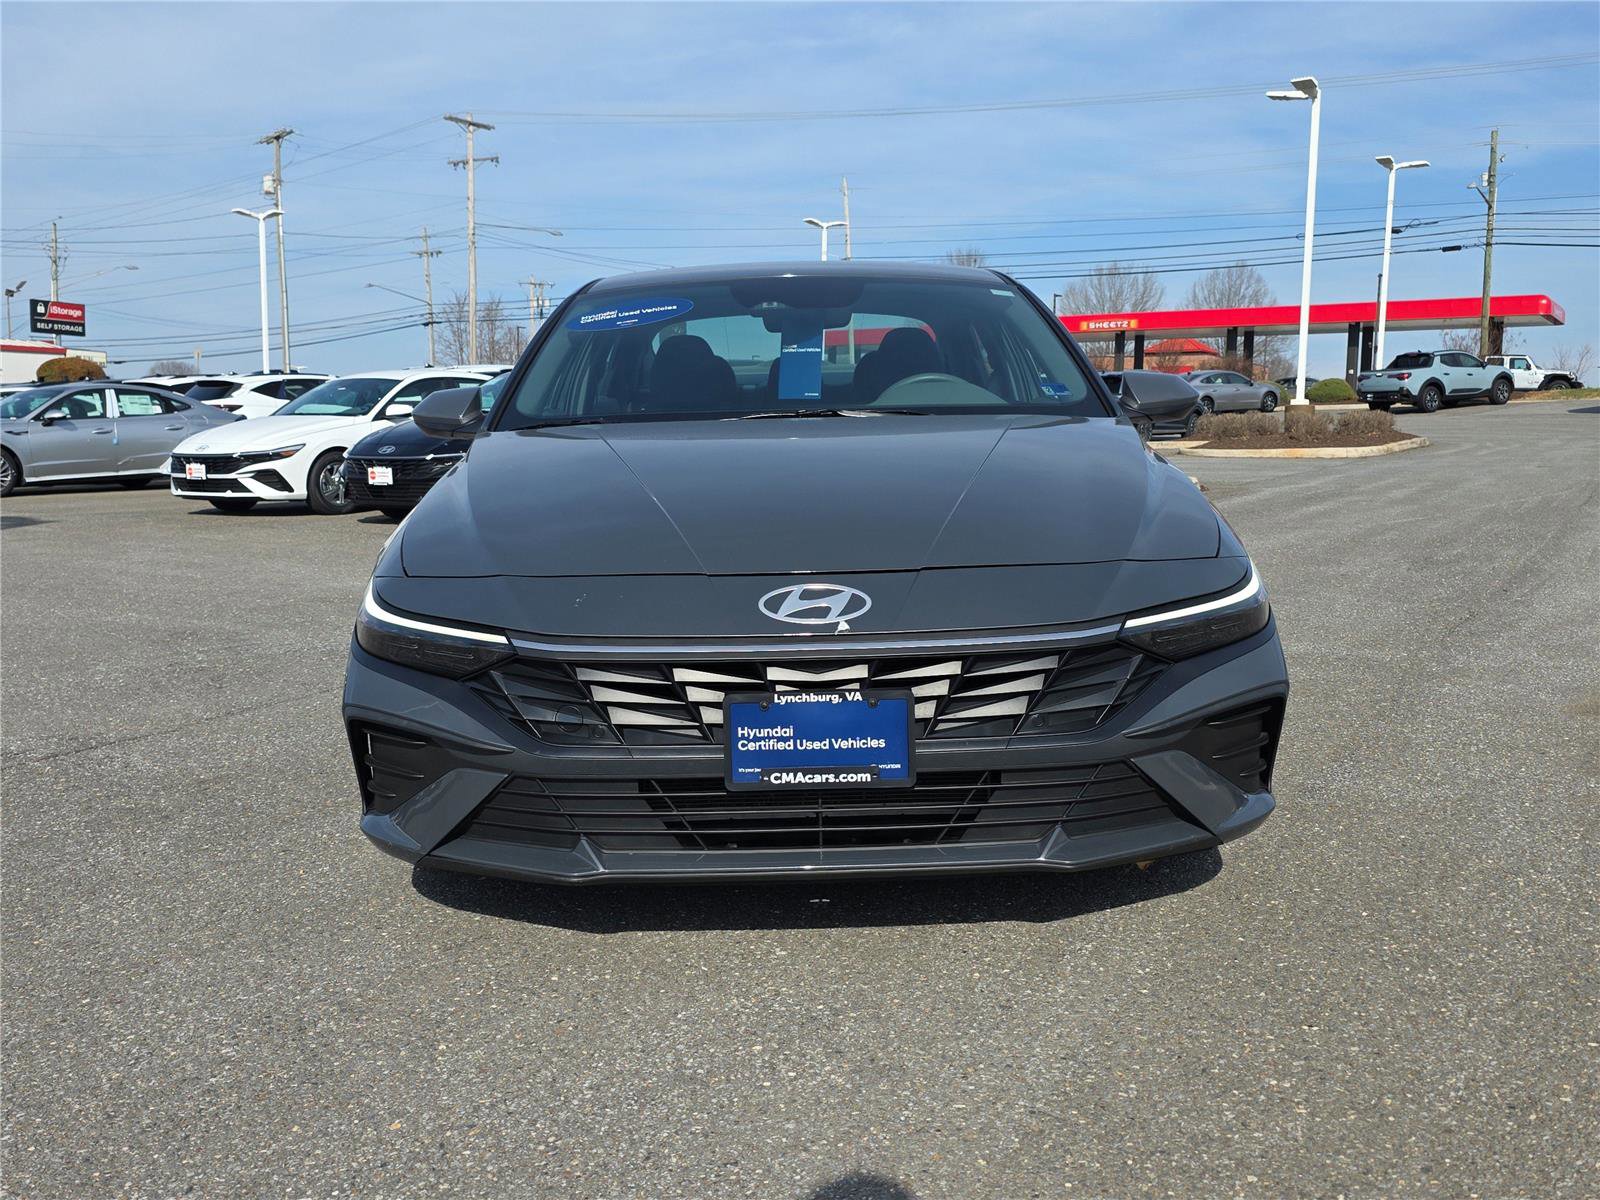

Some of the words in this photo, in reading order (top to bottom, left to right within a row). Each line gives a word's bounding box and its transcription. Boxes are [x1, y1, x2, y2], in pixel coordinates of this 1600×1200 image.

[50, 305, 82, 317] iStorage
[53, 324, 83, 332] STORAGE
[1089, 321, 1128, 329] SHEETZ
[774, 692, 843, 705] Lynchburg,
[845, 691, 863, 702] VA
[737, 725, 794, 739] Hyundai
[737, 739, 794, 751] Certified
[797, 739, 829, 750] Used
[832, 736, 886, 749] Vehicles
[770, 772, 871, 784] CMAcars.com
